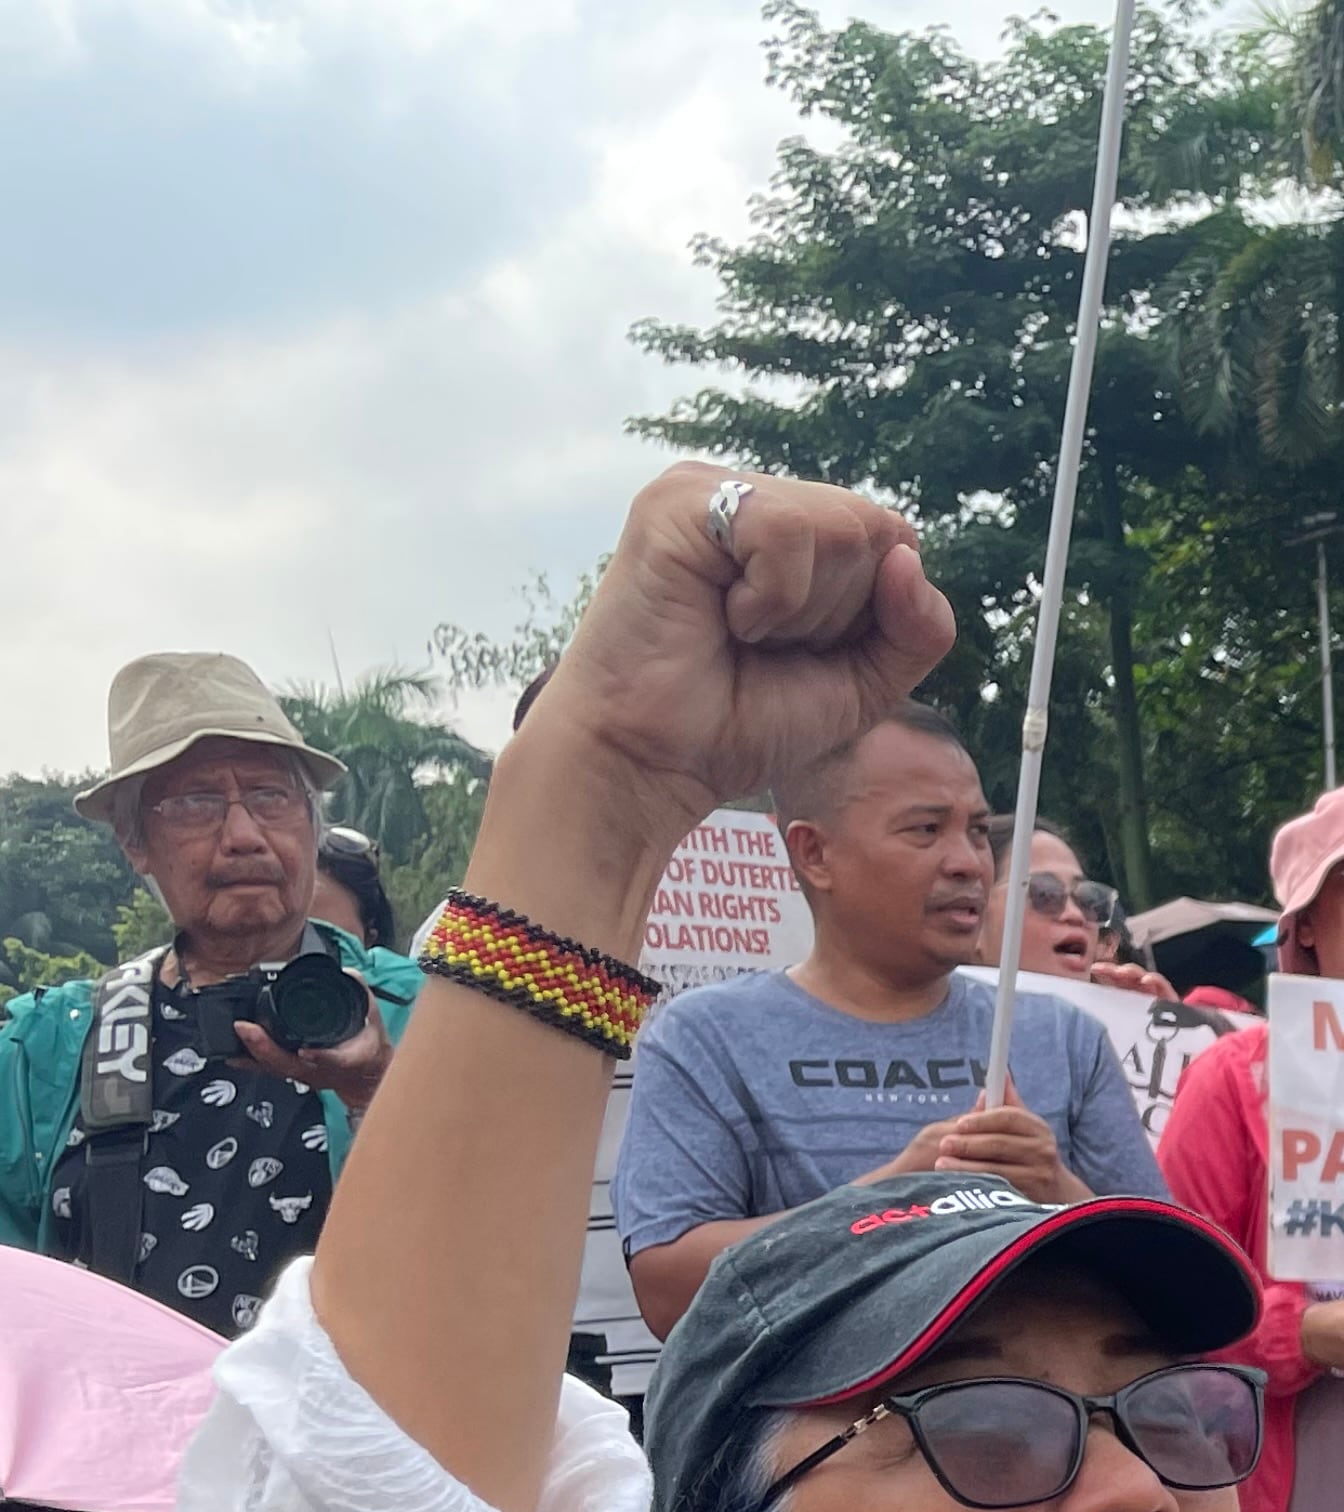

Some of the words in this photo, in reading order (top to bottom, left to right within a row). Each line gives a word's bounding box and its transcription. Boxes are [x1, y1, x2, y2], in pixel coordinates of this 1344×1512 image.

[732, 829, 776, 857] THE
[667, 857, 696, 883] OF
[698, 892, 781, 923] RIGHTS
[644, 921, 771, 955] OLATIONS!
[906, 1093, 951, 1104] YORK
